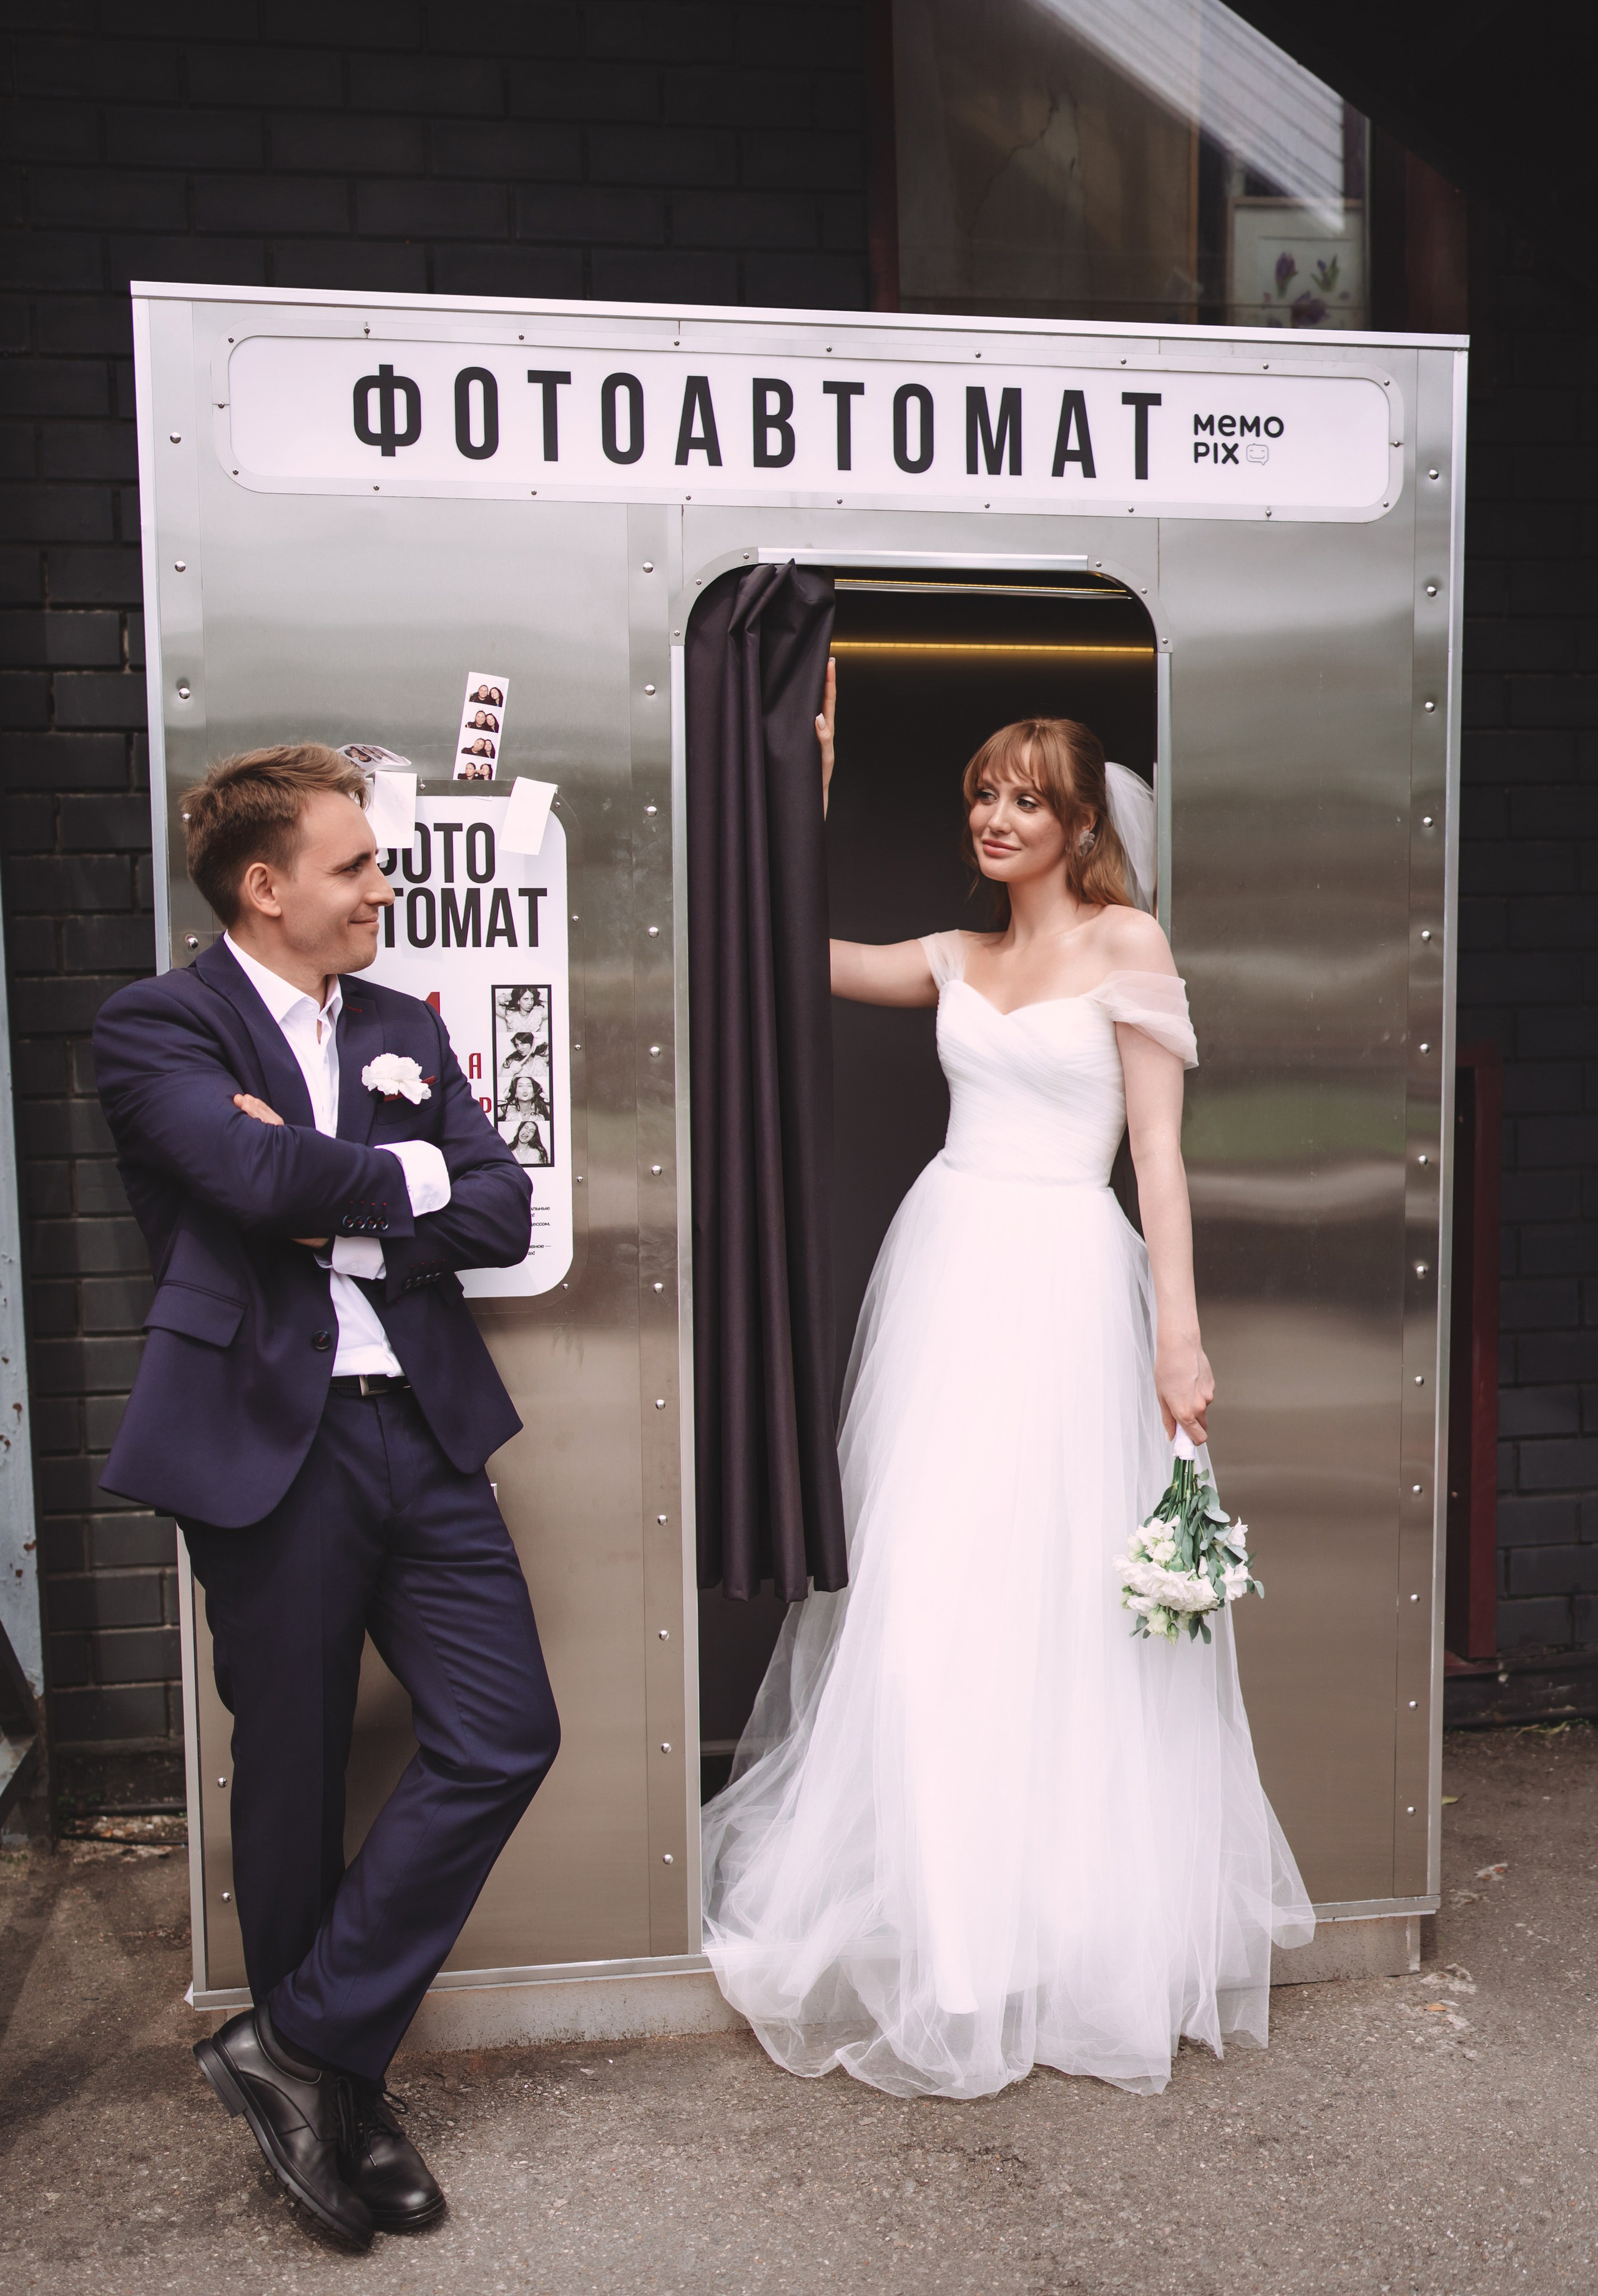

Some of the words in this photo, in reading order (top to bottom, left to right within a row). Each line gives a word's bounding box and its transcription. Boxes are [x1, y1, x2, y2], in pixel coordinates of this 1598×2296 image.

[353, 364, 1162, 480] ФОТОАВТОМАТ
[1194, 442, 1240, 465] PIX
[376, 821, 496, 884] ОТО
[383, 887, 547, 949] ТОМАТ
